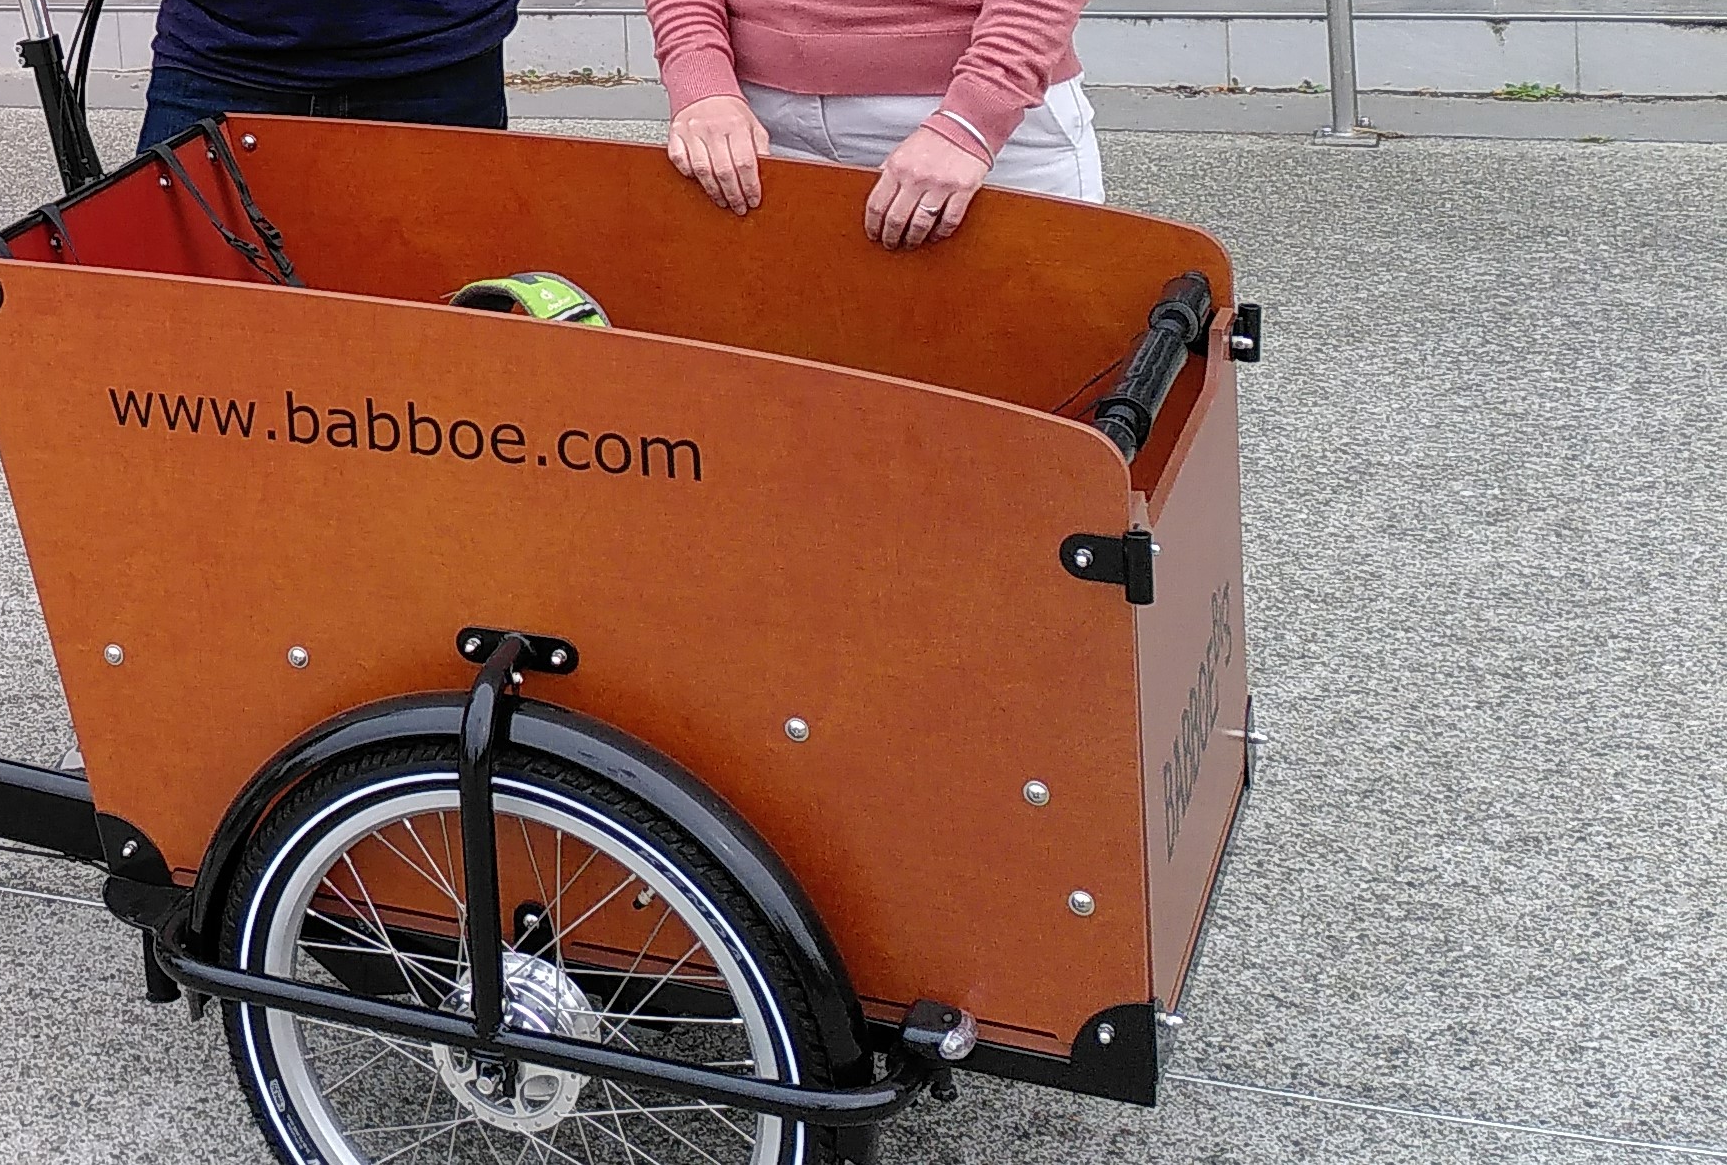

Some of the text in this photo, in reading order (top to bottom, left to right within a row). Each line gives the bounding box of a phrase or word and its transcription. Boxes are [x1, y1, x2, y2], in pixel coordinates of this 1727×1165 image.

[107, 387, 704, 483] www.babboe.com
[1163, 634, 1219, 866] BABBOE
[637, 848, 743, 962] KENDA
